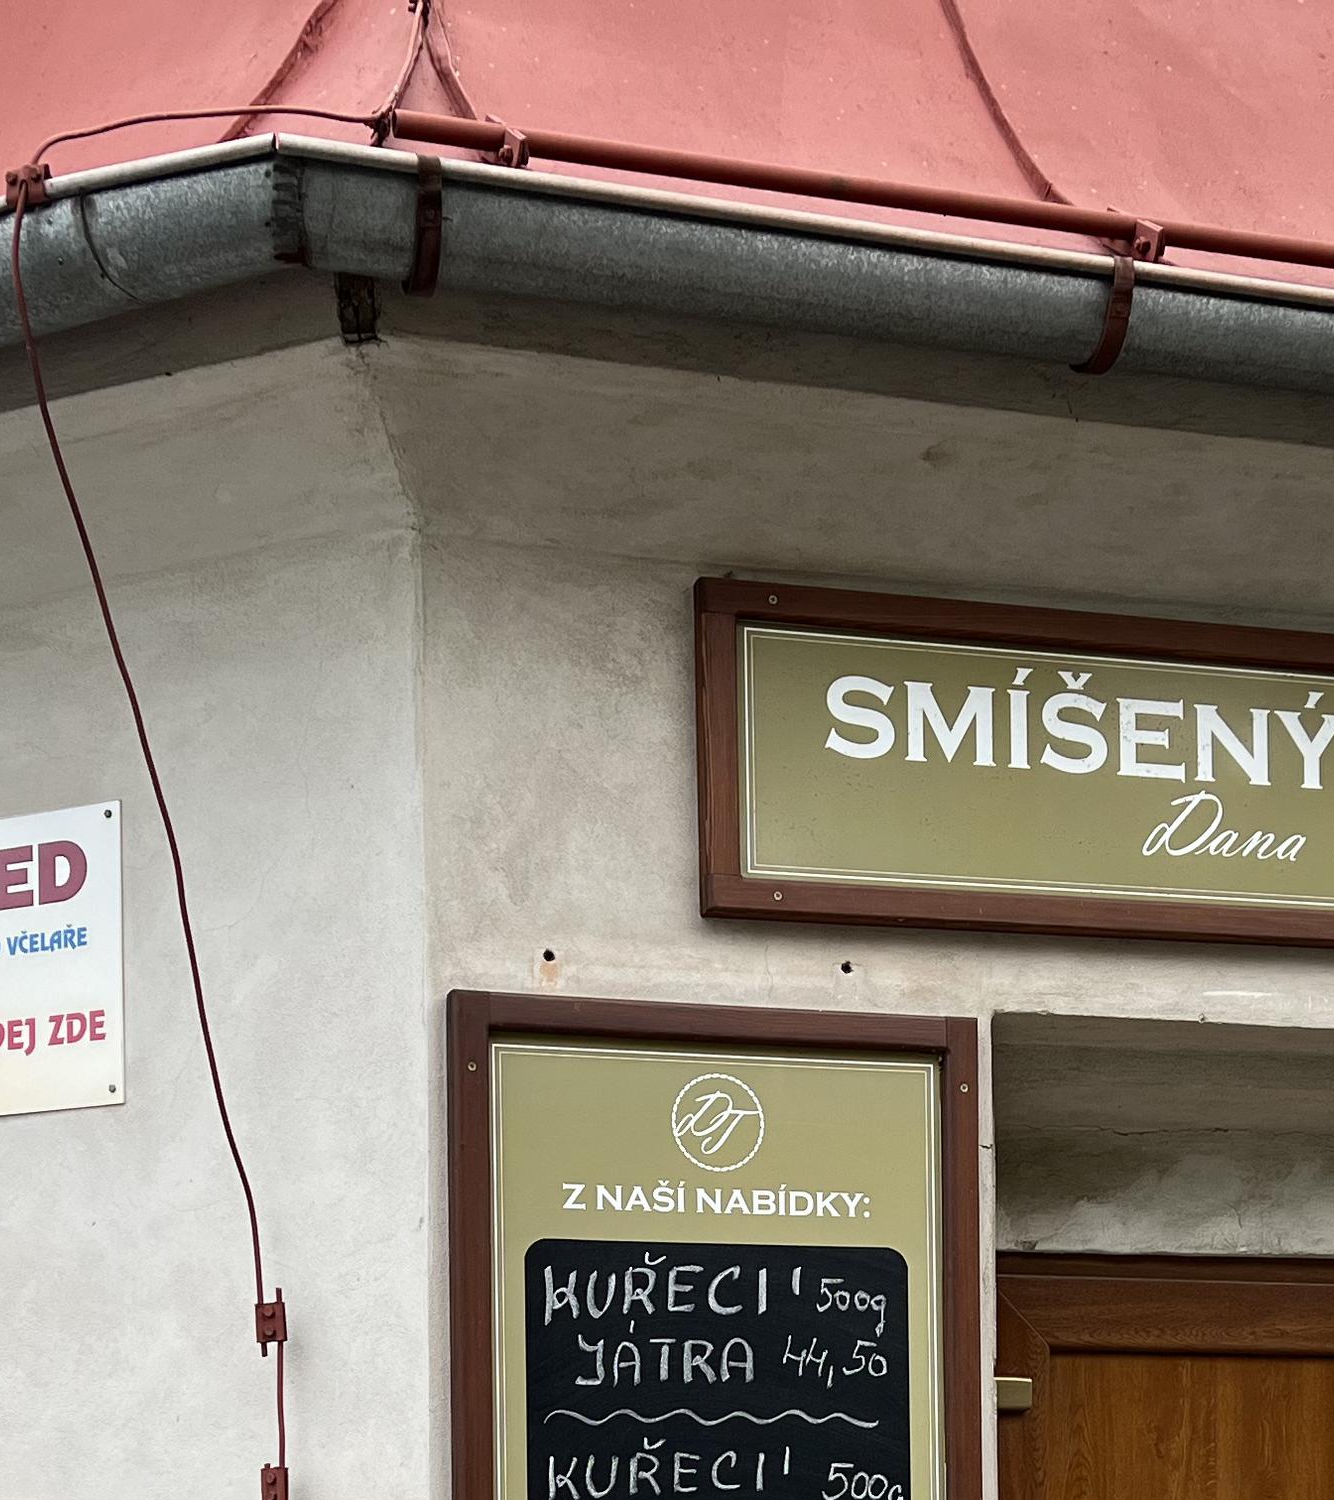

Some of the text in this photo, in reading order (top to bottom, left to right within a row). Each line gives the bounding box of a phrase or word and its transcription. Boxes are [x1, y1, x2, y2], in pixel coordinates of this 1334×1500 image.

[1143, 791, 1309, 863] Dana
[6, 924, 88, 957] VČELAŘE
[47, 1009, 107, 1046] ZDE
[562, 1180, 871, 1219] Z NAŠÍ NABÍDKY:
[815, 1277, 888, 1337] 500g
[575, 1320, 888, 1390] JÁTRA 44,50
